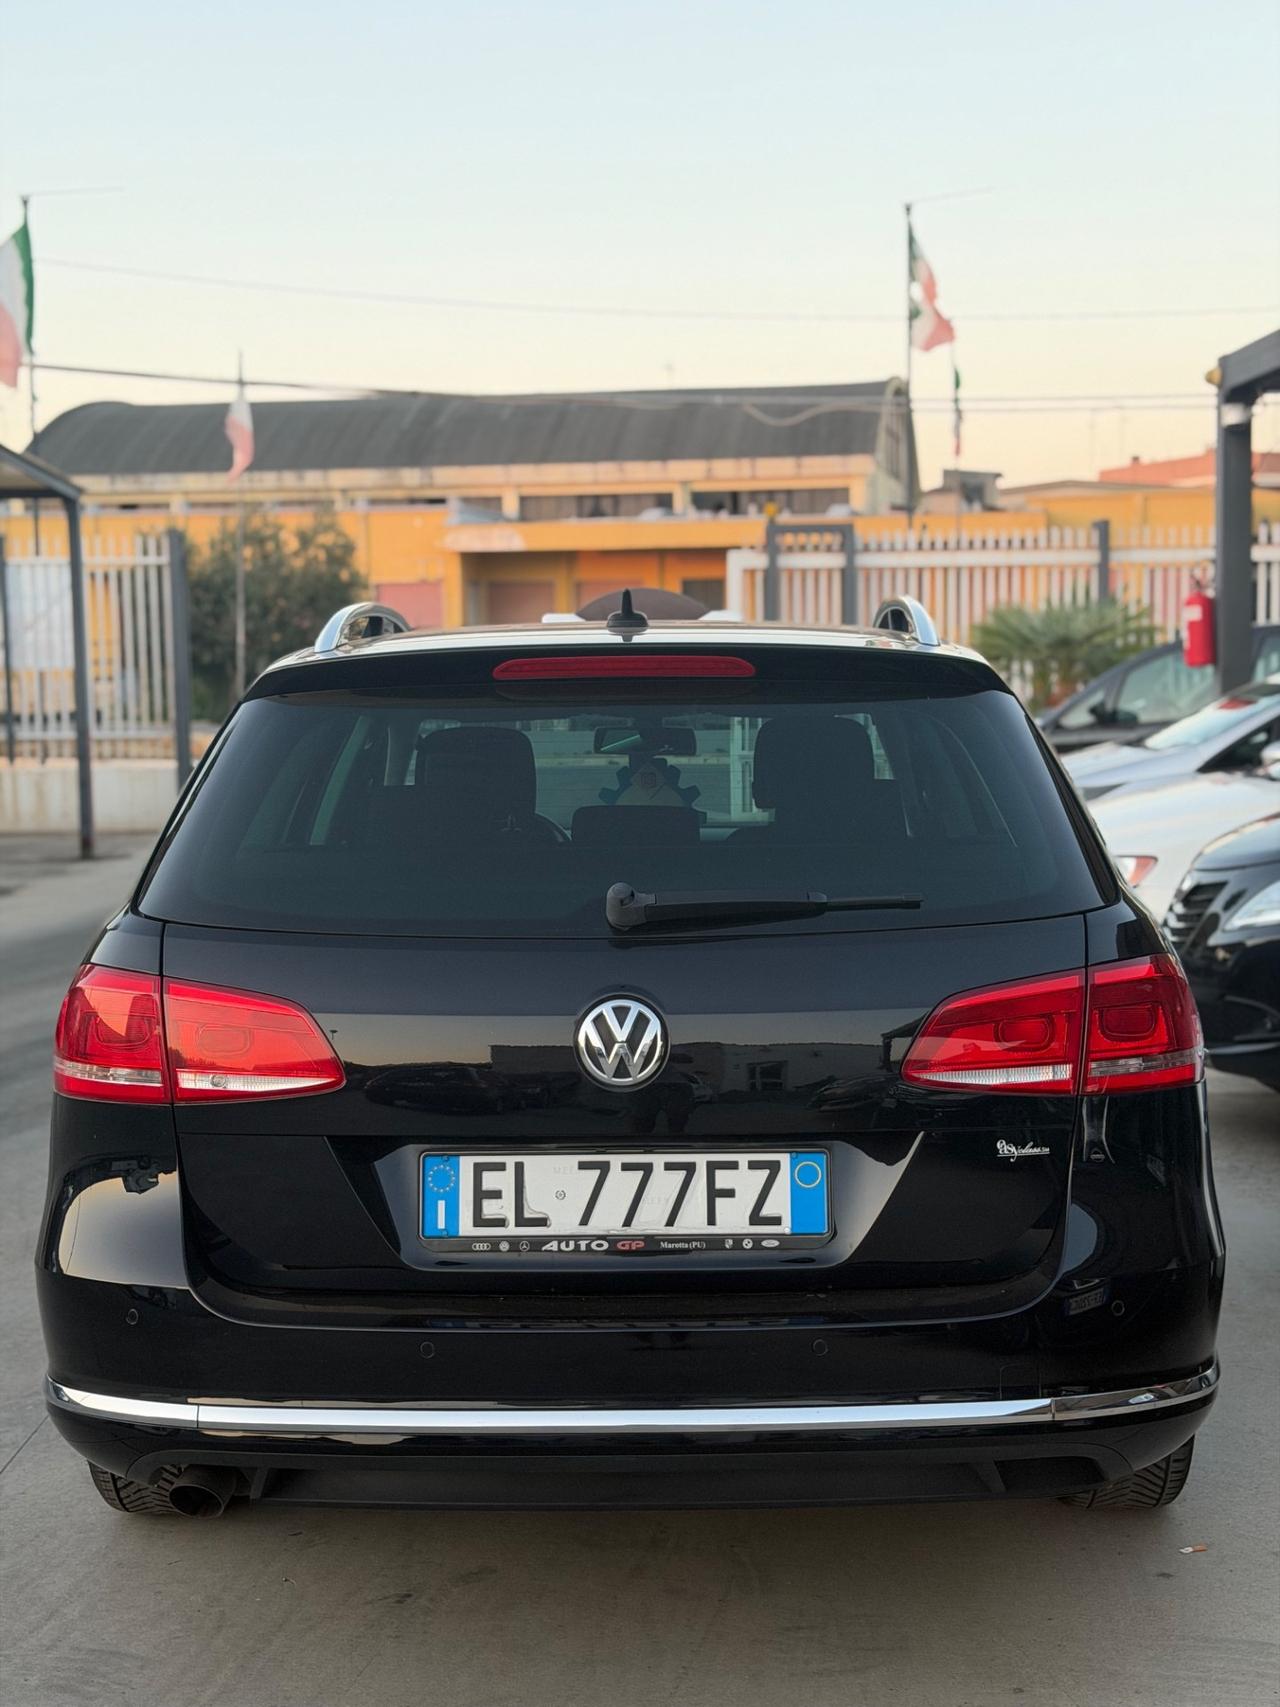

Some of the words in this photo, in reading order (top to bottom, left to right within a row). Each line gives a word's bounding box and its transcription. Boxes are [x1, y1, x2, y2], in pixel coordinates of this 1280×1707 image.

[472, 1161, 549, 1228] EL
[577, 1159, 782, 1228] 777FZ
[541, 1240, 609, 1251] AUTO
[616, 1240, 645, 1251] GP
[660, 1241, 689, 1249] Marotta
[689, 1241, 706, 1250] (PU)
